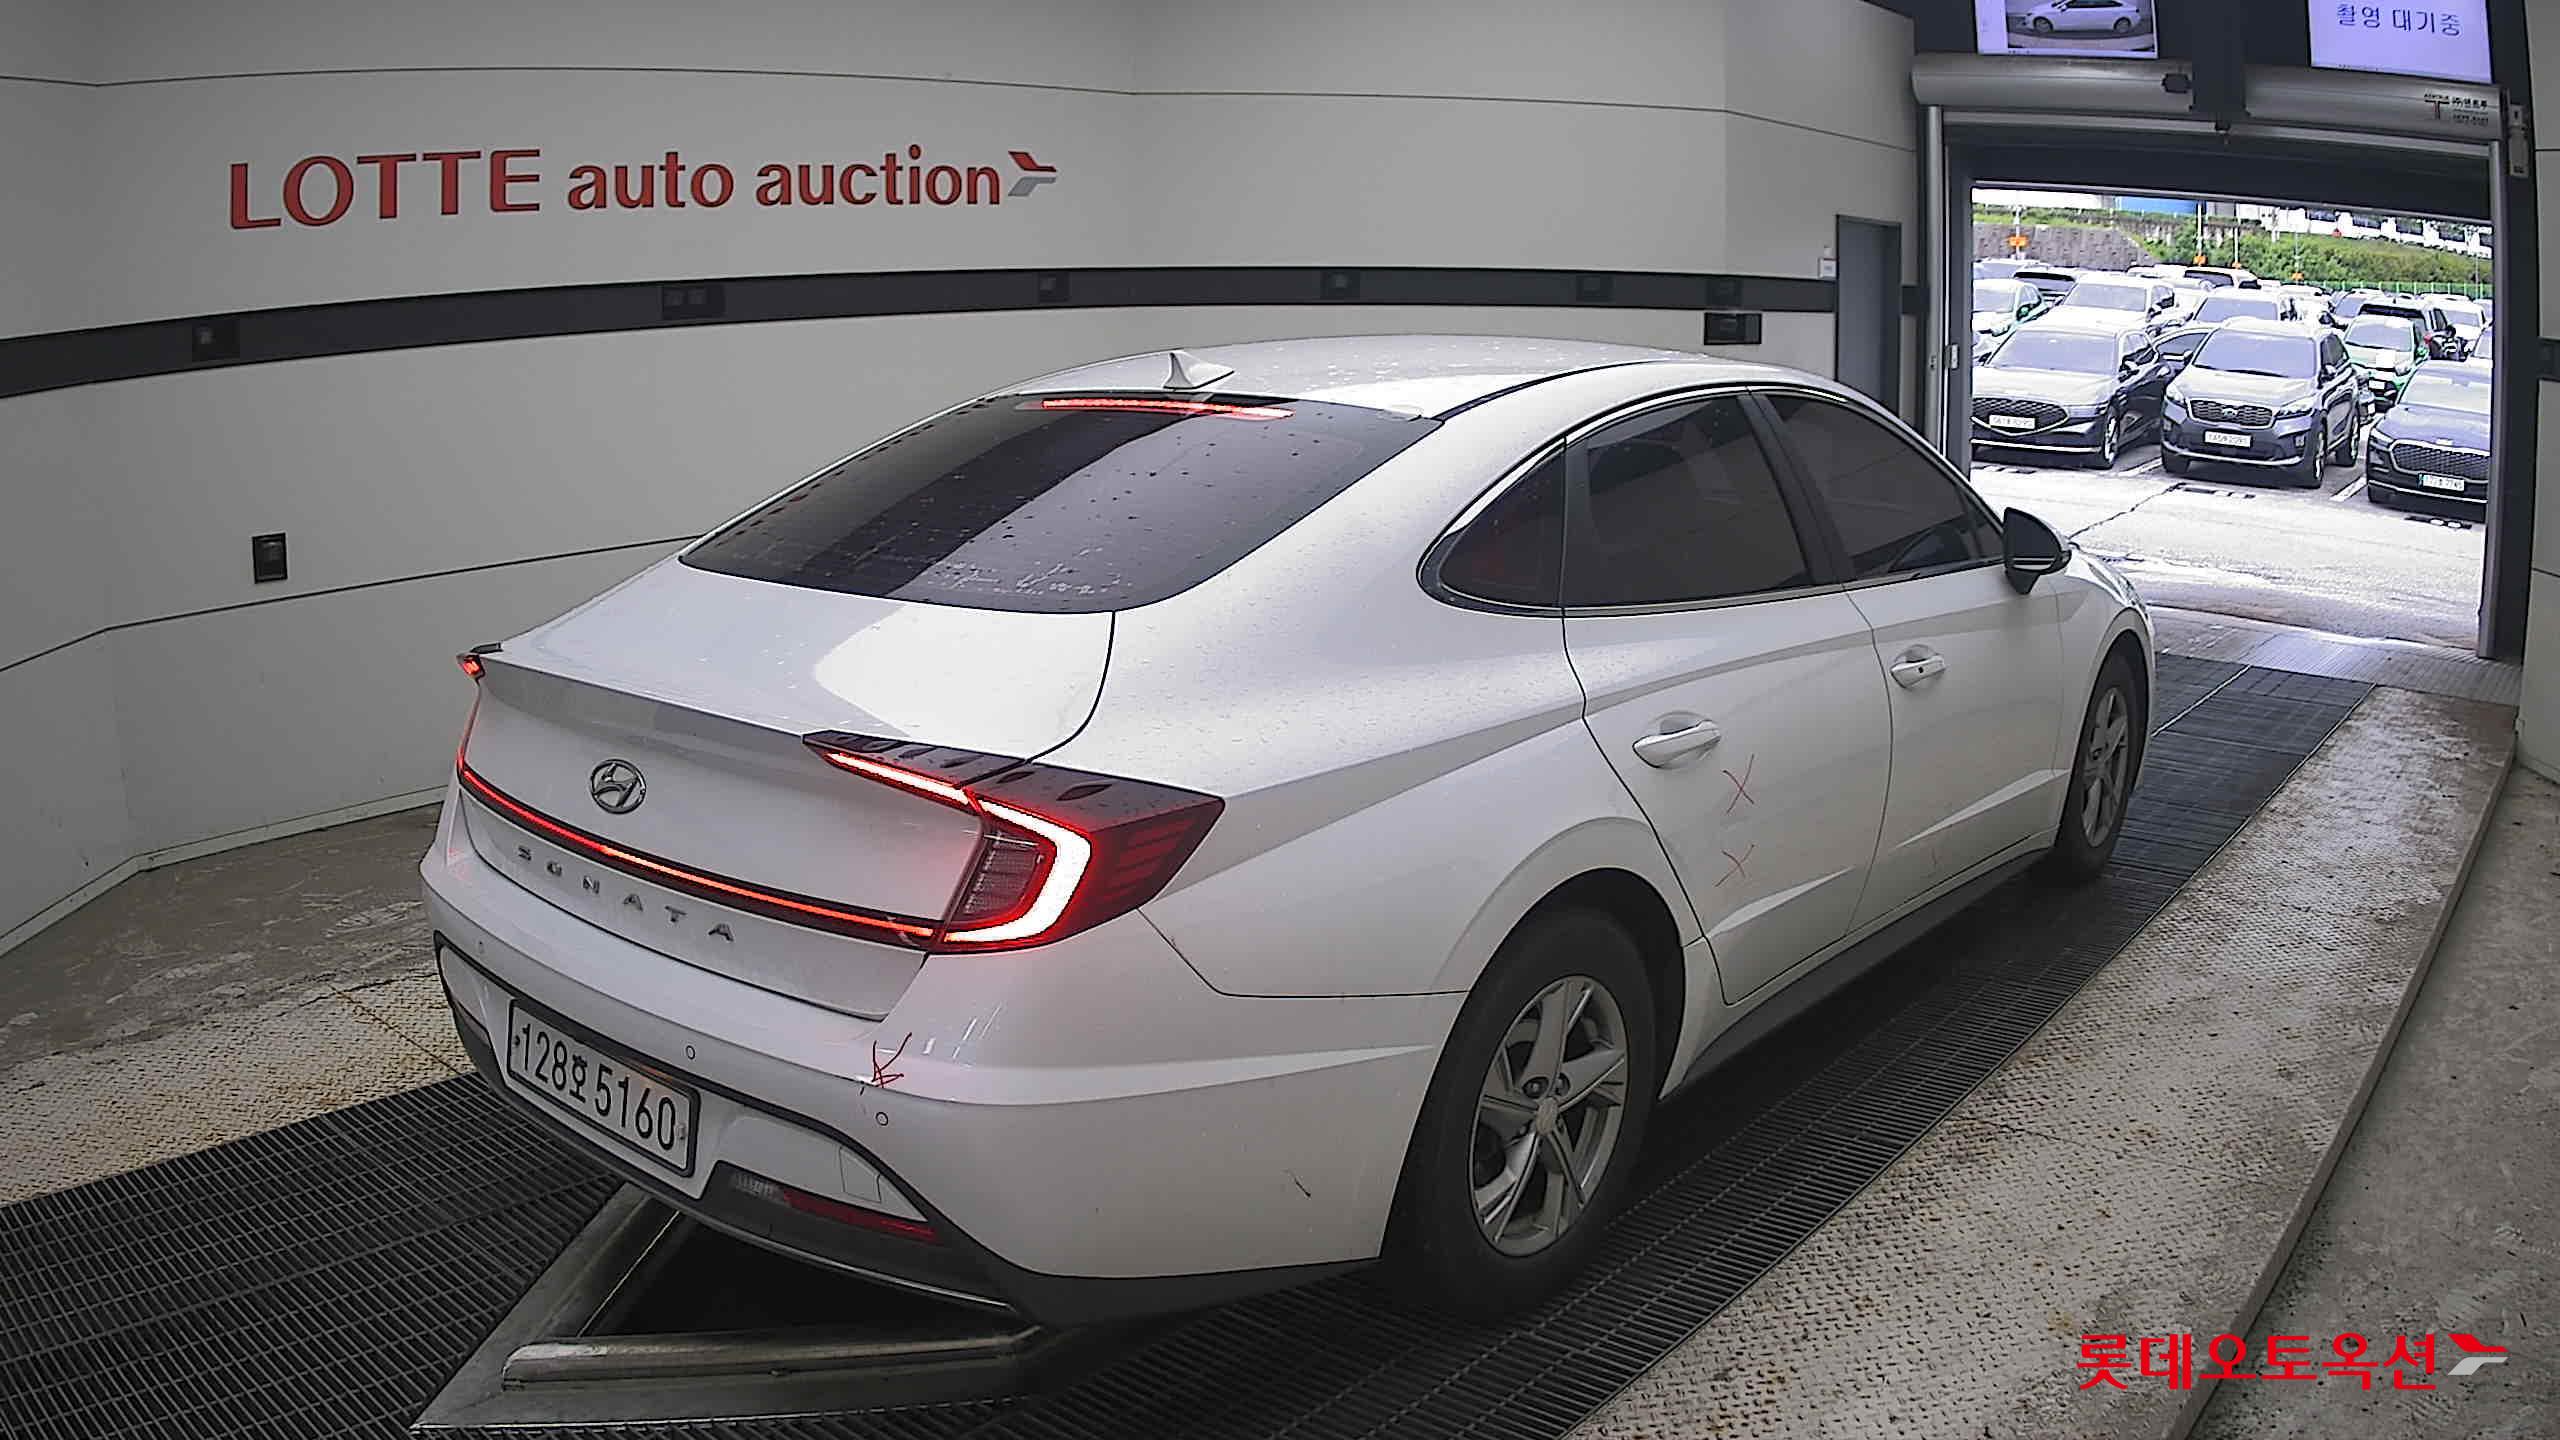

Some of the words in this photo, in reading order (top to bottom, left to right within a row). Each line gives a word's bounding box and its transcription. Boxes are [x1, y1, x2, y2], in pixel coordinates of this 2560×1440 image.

[2392, 9, 2460, 37] 대기중
[231, 149, 541, 230] LOTTE
[567, 151, 735, 210] auto
[755, 145, 1002, 206] auction
[517, 845, 735, 942] SONATA
